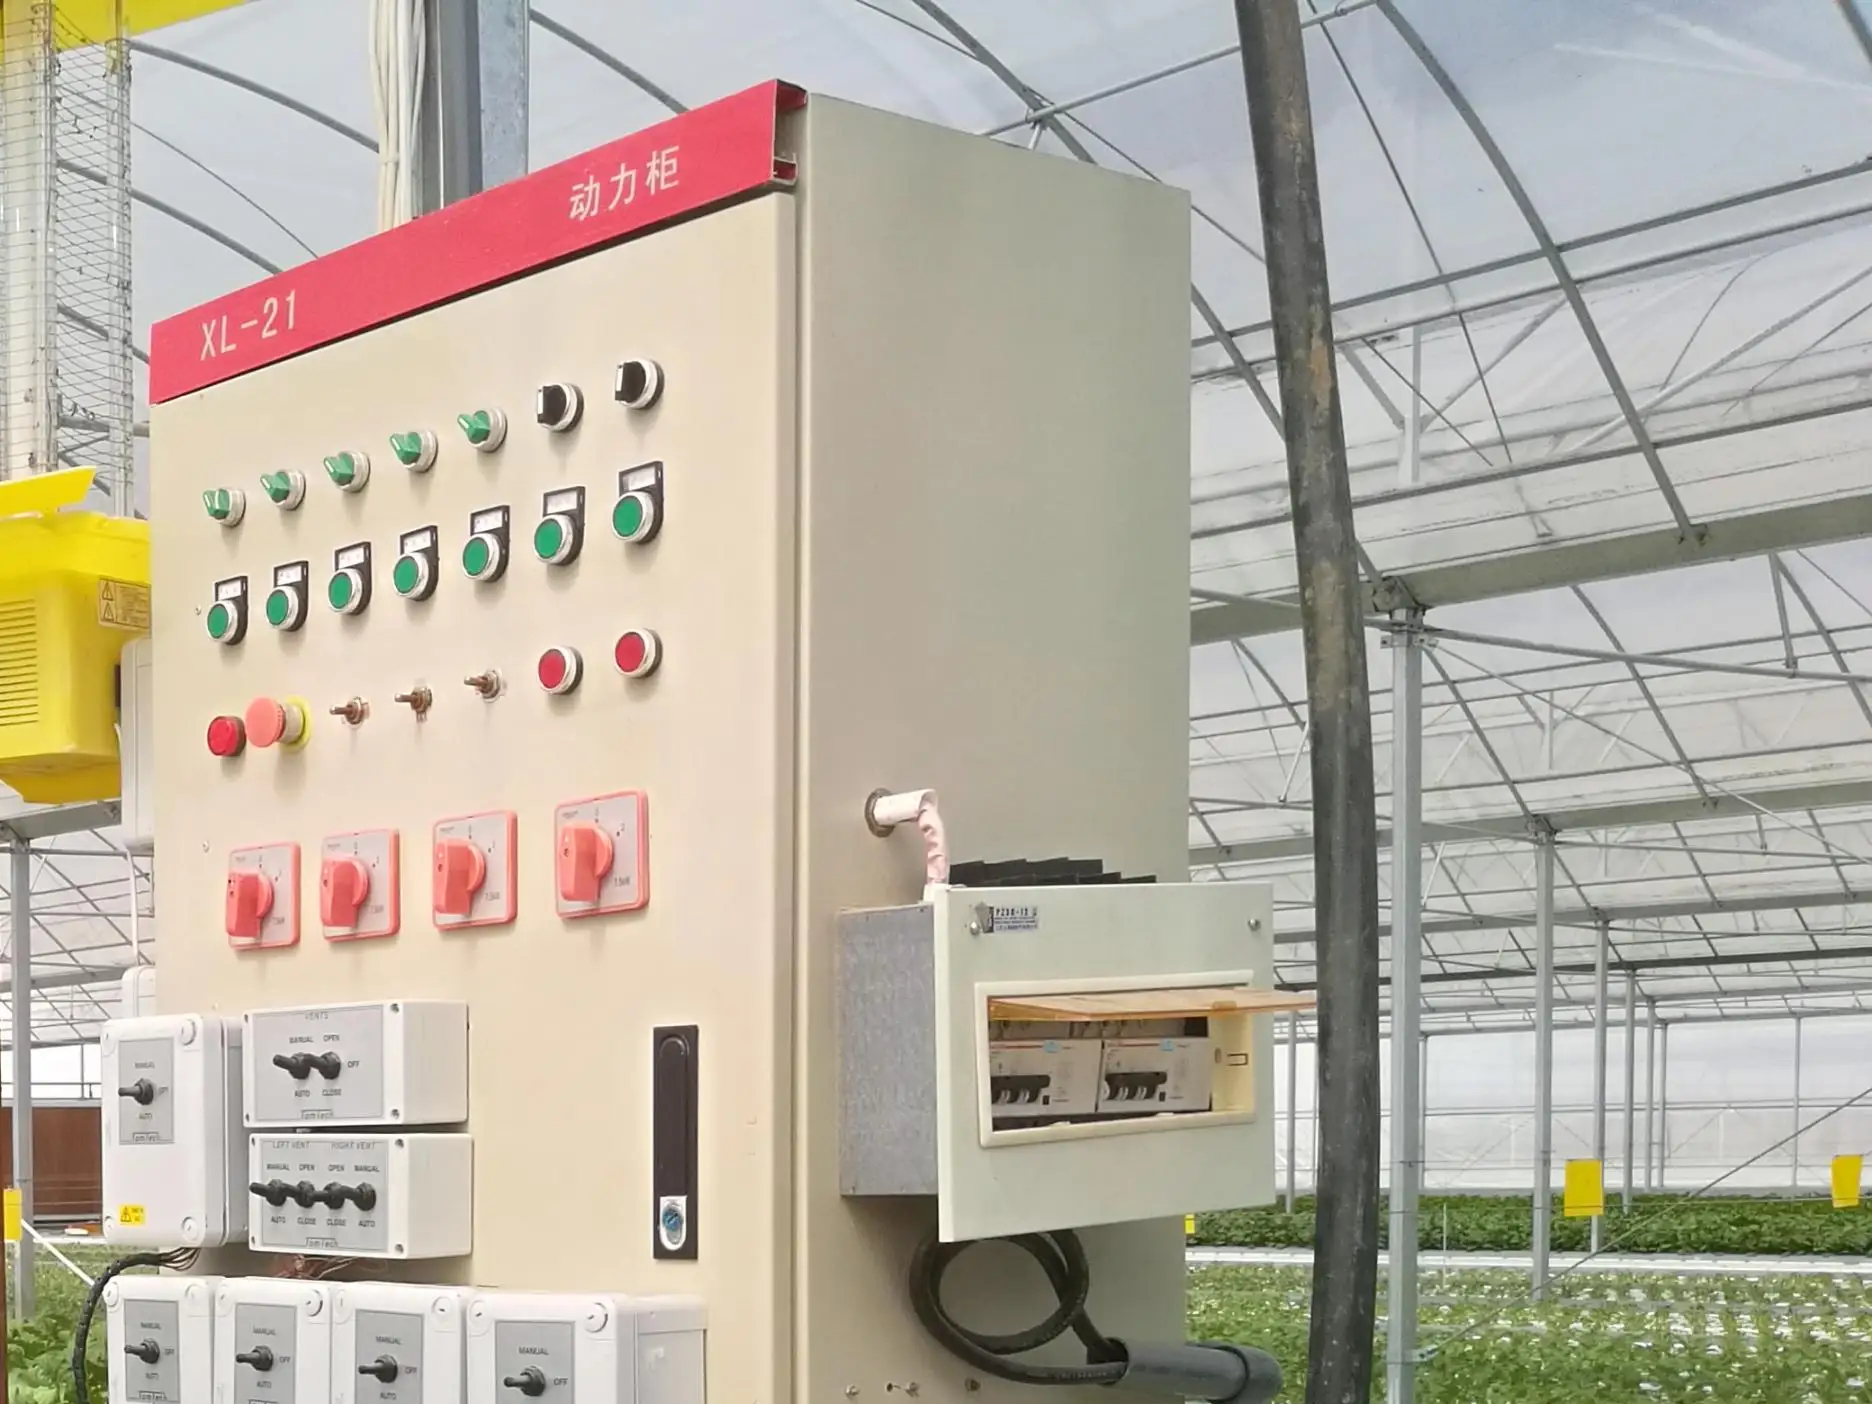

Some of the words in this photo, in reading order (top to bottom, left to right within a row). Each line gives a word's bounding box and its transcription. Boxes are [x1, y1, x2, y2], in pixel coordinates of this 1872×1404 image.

[568, 145, 680, 221] 动力柜
[200, 289, 296, 361] XL-21
[289, 1036, 314, 1044] MANUAL
[323, 1034, 340, 1042] OPEN
[347, 1060, 360, 1068] OFF
[294, 1089, 311, 1098] AUTO
[322, 1088, 342, 1097] CLOSE
[328, 1164, 345, 1172] OPEN
[271, 1216, 286, 1224] AUTO
[297, 1217, 316, 1225] CLOSE
[326, 1218, 346, 1227] CLOSE
[358, 1220, 375, 1228] AUTO
[376, 1336, 402, 1345] MANUAL
[518, 1347, 549, 1356] MANUAL
[279, 1356, 291, 1364] OFF
[405, 1366, 418, 1374] OFF
[554, 1378, 568, 1386] OFF
[380, 1392, 396, 1400] AUTO
